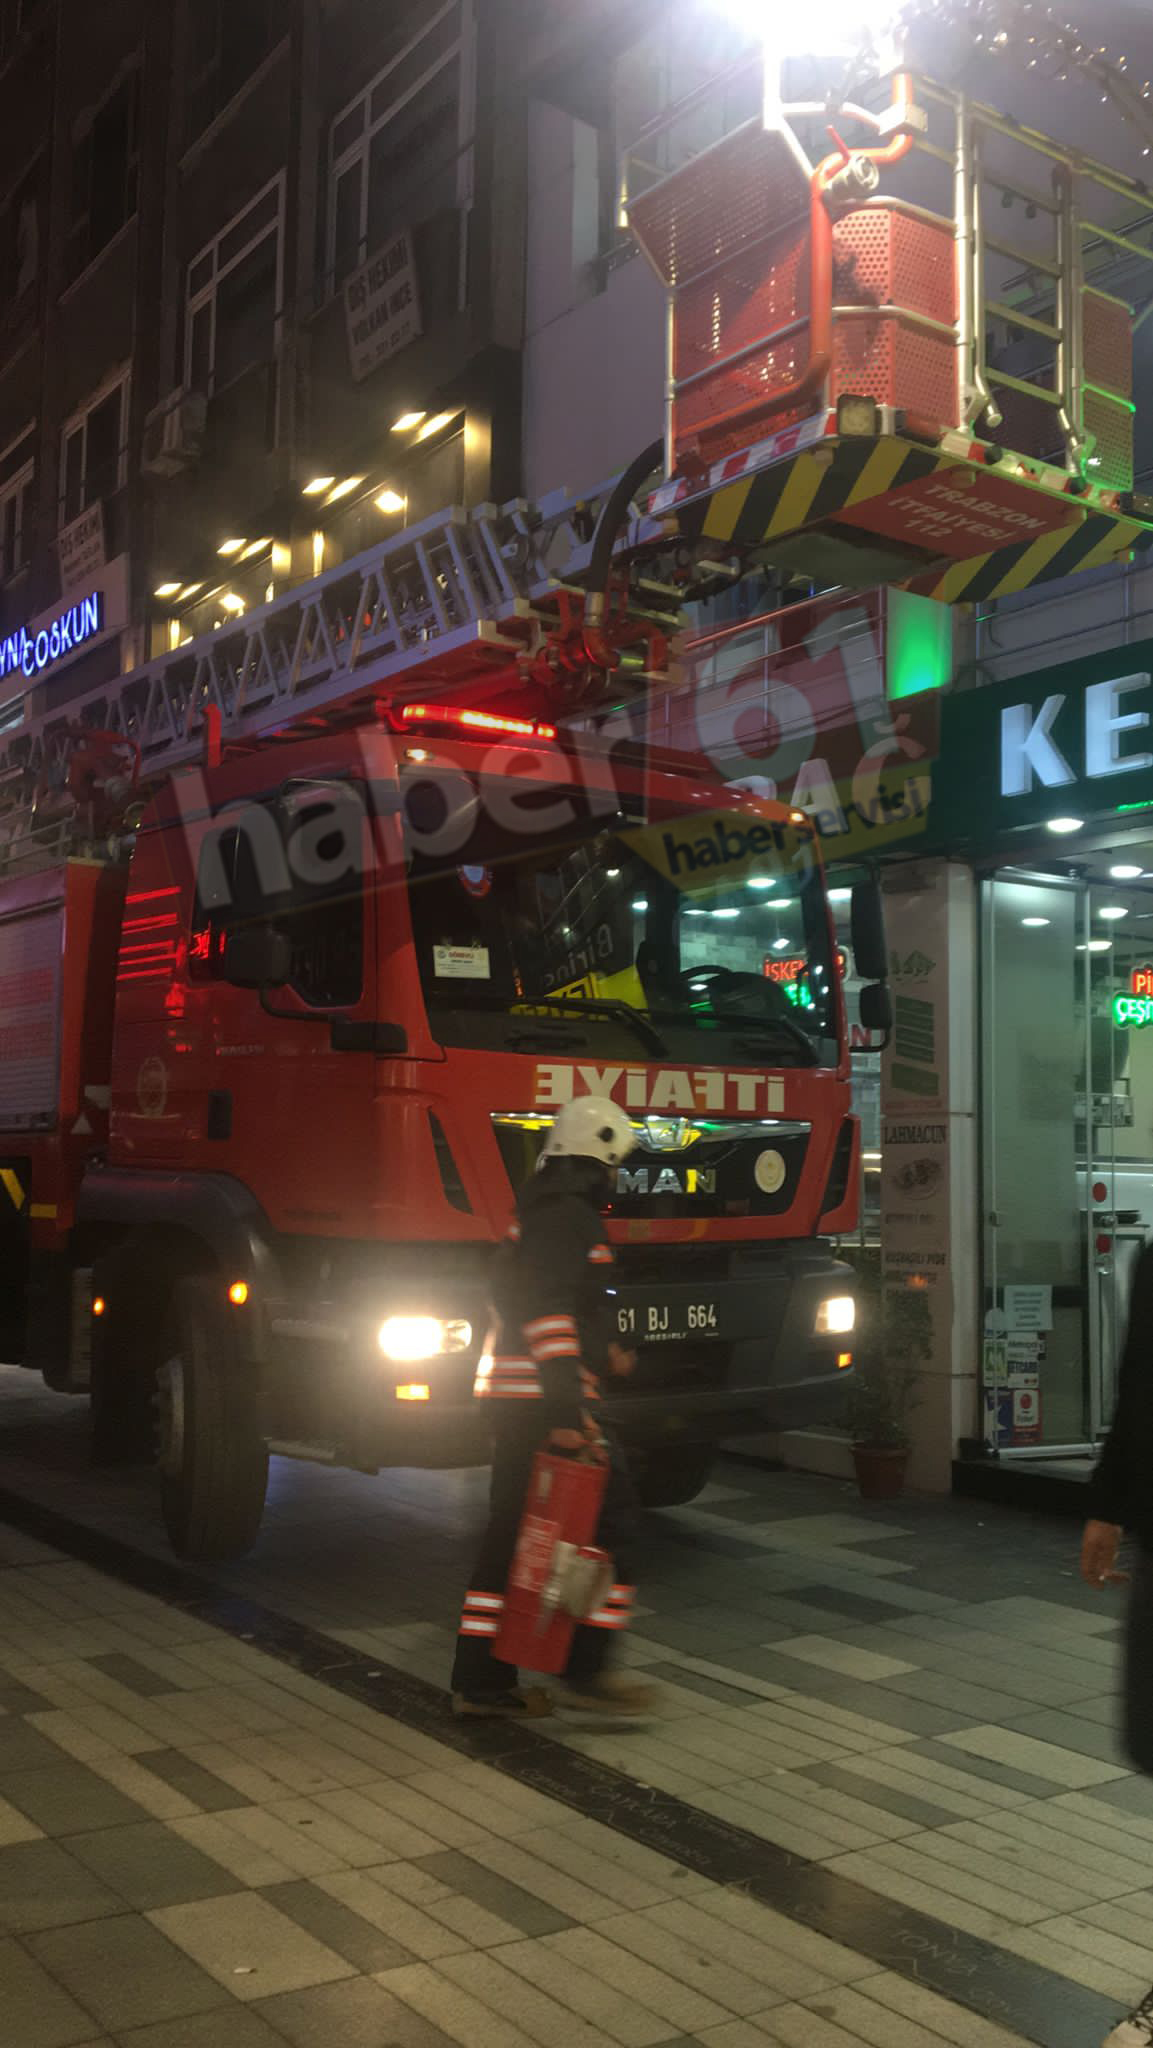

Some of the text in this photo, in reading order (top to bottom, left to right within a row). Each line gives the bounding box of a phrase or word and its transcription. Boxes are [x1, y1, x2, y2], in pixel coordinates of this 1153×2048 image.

[888, 496, 1017, 540] İTFAİYESİ
[926, 484, 1047, 529] TRABZON
[904, 519, 952, 537] 112
[1001, 672, 1153, 797] KE
[885, 1125, 946, 1144] LAHMACUN
[616, 1168, 716, 1193] MAN
[618, 1304, 717, 1332] 61 BJ 664
